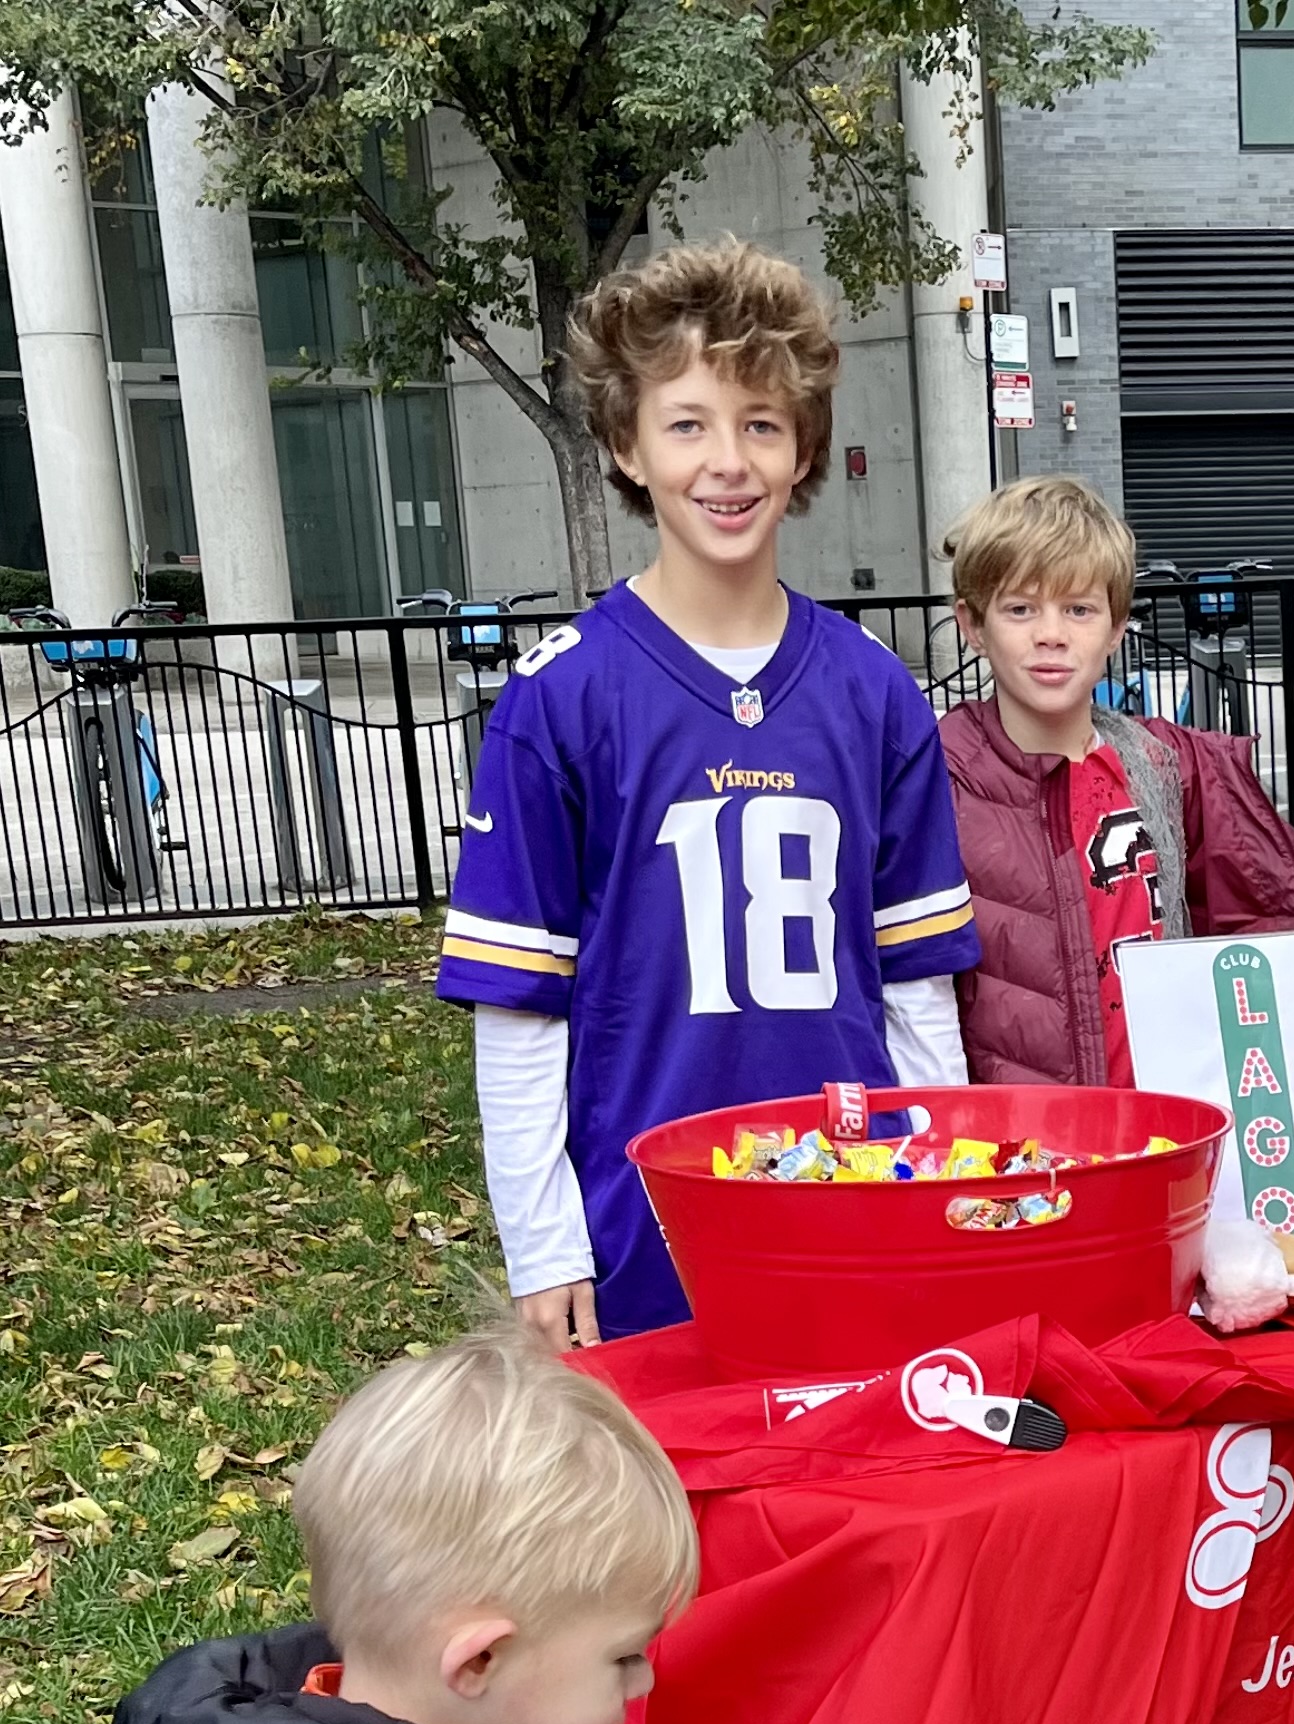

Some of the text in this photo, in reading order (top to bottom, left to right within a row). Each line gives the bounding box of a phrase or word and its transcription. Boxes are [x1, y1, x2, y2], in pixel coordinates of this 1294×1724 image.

[738, 704, 760, 722] NFL
[655, 795, 841, 1015] 18
[1220, 950, 1262, 972] CLUB
